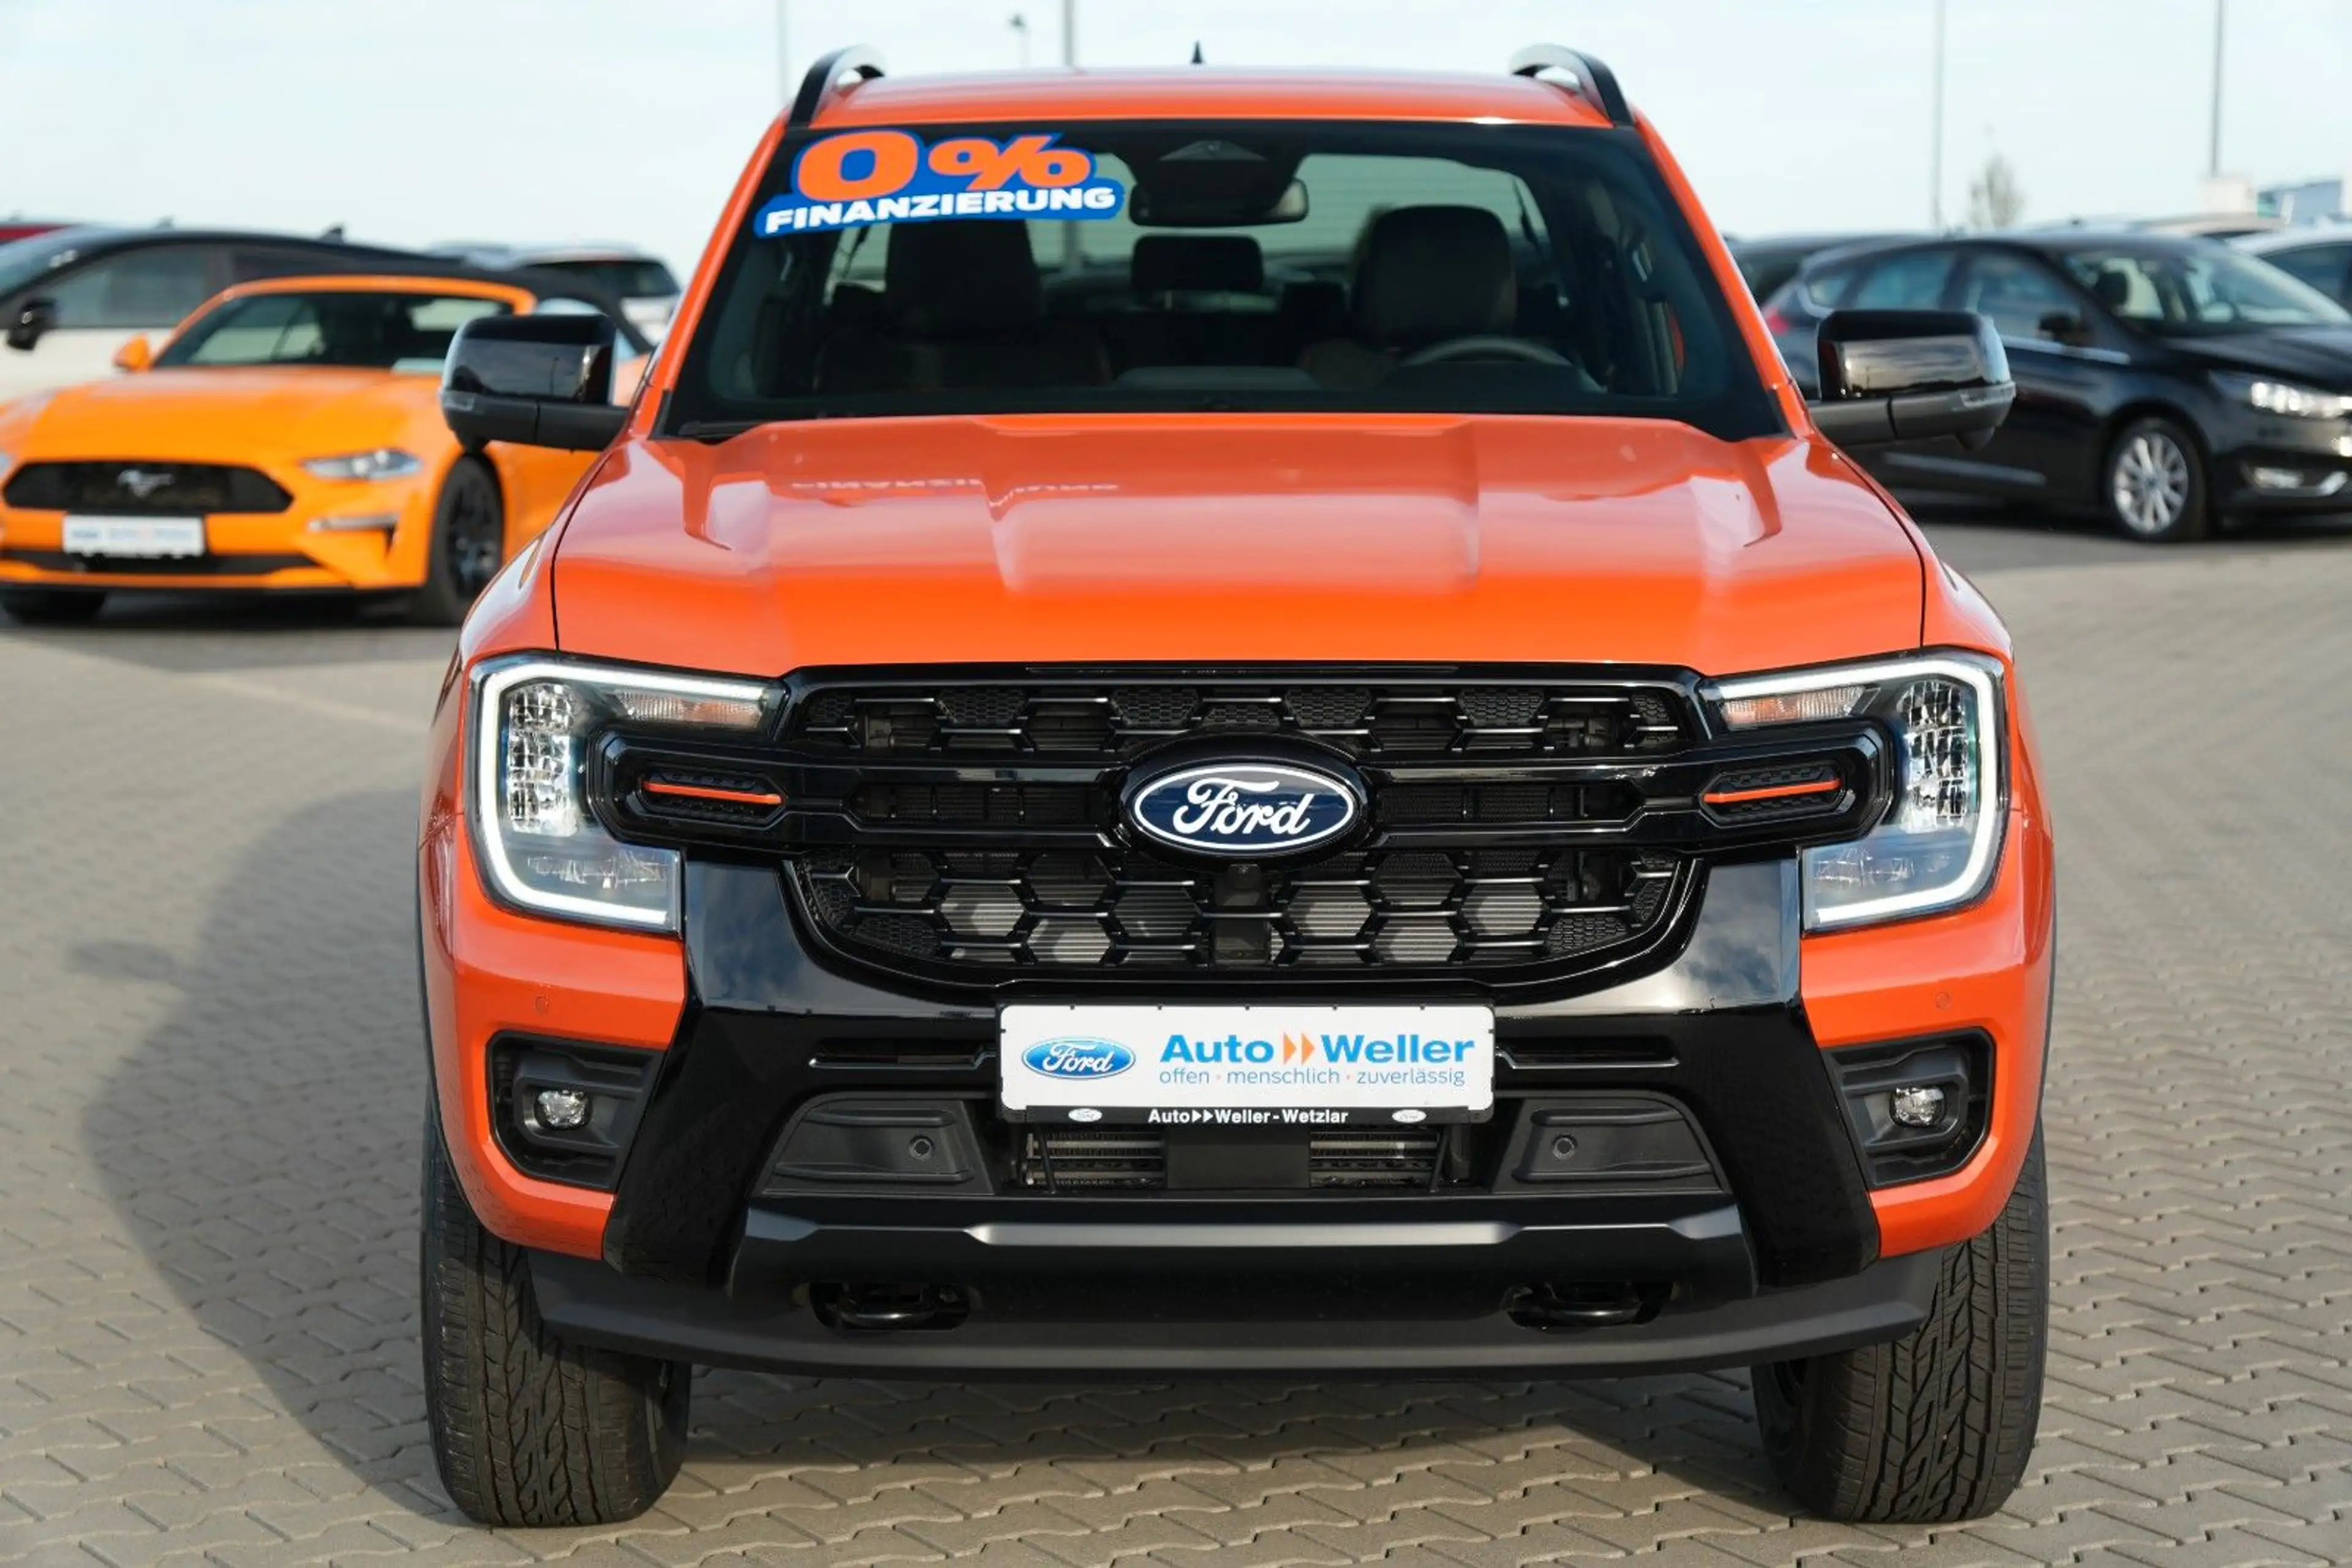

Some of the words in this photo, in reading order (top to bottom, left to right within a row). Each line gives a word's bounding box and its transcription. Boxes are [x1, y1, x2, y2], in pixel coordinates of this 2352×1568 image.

[765, 187, 1115, 234] FINANZIERUNG
[1172, 777, 1314, 835] Ford
[1042, 1043, 1115, 1072] Ford
[1160, 1035, 1274, 1063] Auto
[1321, 1035, 1475, 1063] Weller
[1159, 1068, 1210, 1084] offen
[1227, 1068, 1340, 1084] menschlich
[1357, 1068, 1465, 1087] zuverlässig
